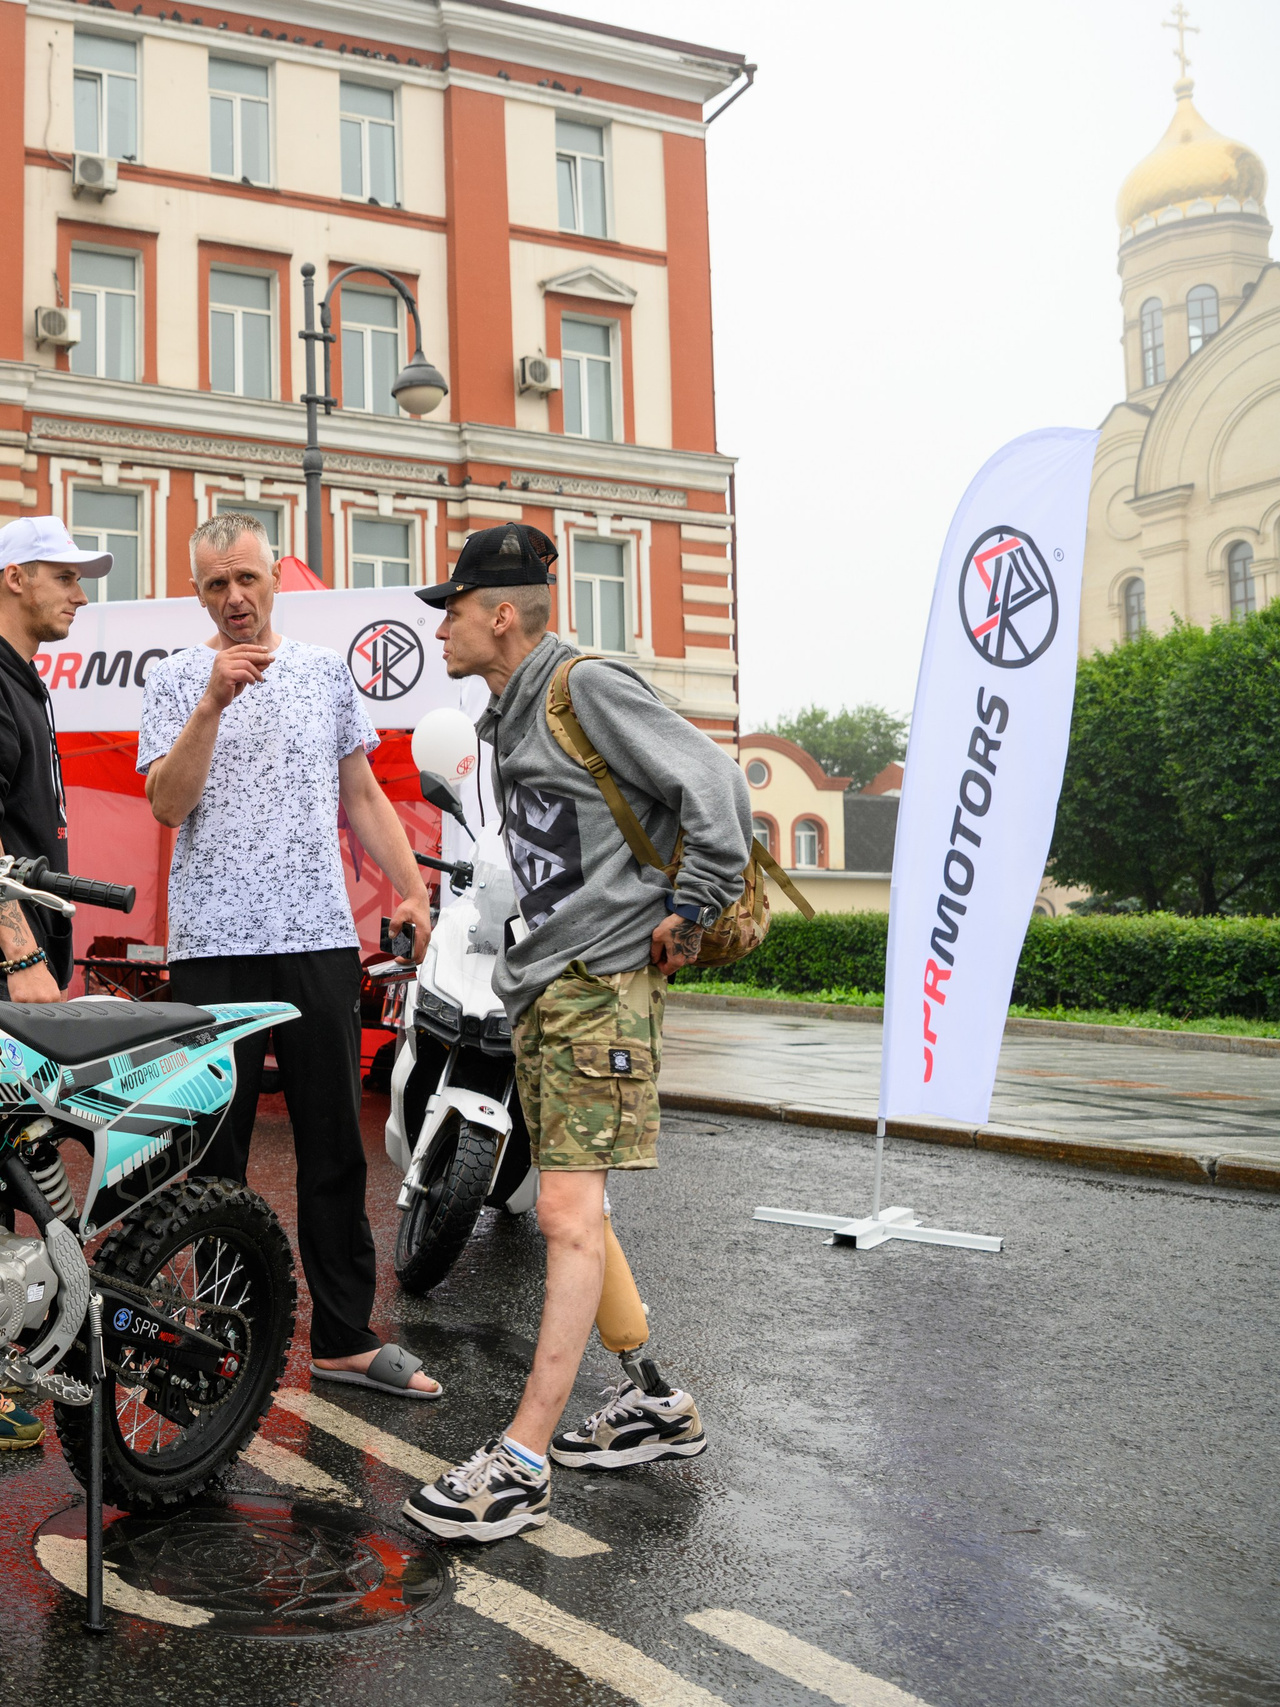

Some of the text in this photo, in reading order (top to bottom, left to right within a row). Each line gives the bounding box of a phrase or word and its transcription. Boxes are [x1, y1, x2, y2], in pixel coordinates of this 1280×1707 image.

[120, 1050, 189, 1094] MOTOPRO EDITION
[132, 1317, 159, 1339] SPR
